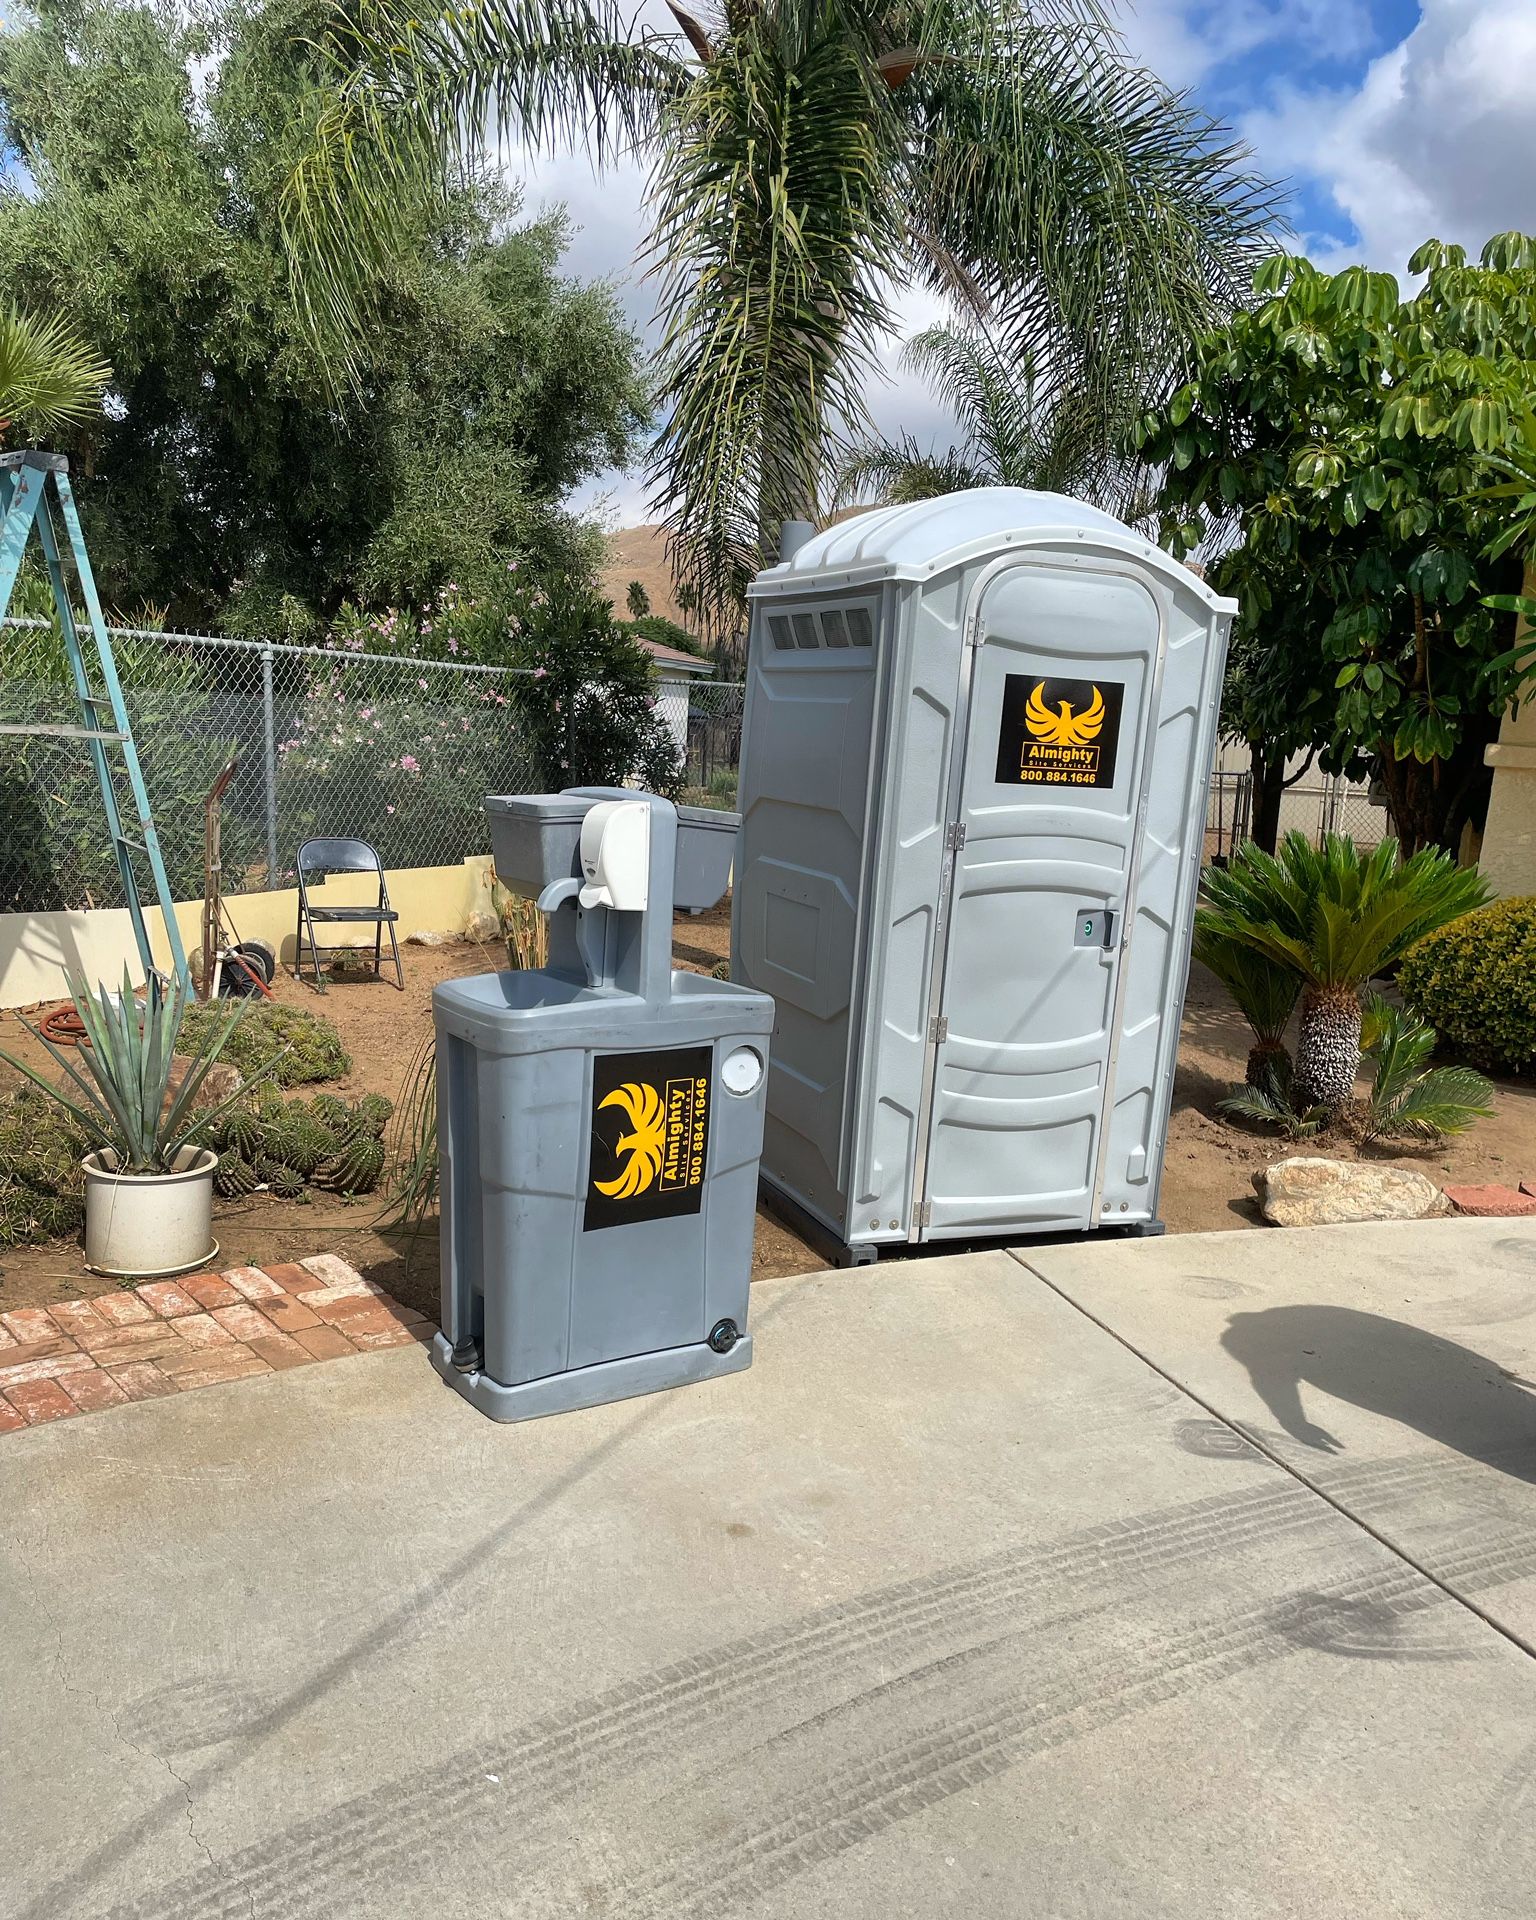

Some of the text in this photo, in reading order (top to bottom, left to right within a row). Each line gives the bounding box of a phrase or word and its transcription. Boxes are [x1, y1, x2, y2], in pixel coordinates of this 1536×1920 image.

[1020, 770, 1096, 783] 800.884.1646
[1028, 745, 1094, 763] Almighty
[663, 1089, 686, 1181] Almighty
[679, 1090, 691, 1178] Site Services
[690, 1078, 707, 1185] 800.884.1646
